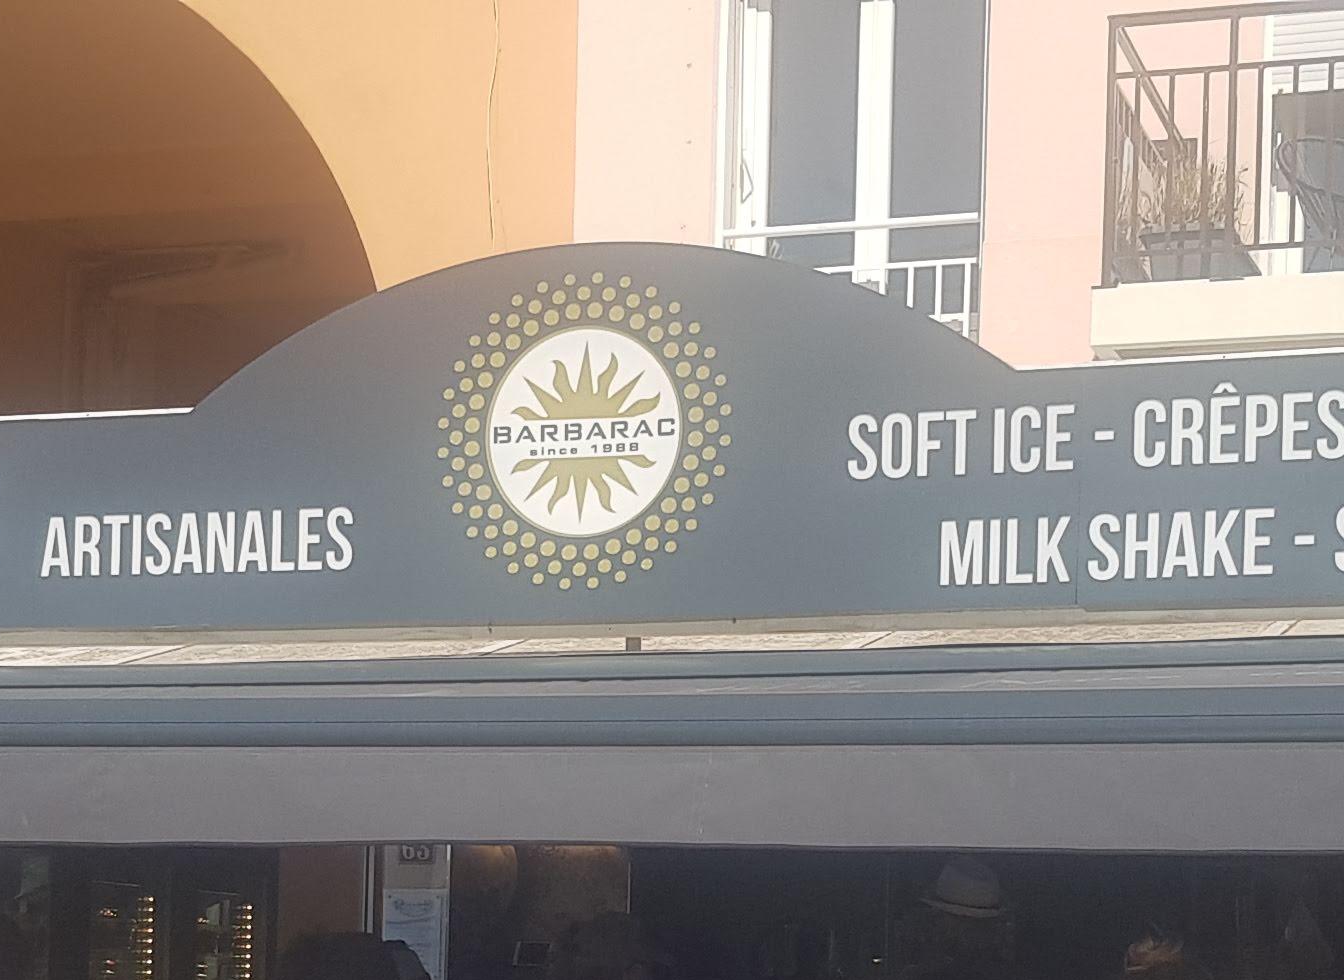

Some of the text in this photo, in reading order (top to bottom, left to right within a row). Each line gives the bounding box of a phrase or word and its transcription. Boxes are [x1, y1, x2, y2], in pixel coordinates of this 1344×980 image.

[493, 417, 676, 445] BARBARAC
[528, 441, 640, 457] since 1988
[847, 409, 977, 480] SOFT
[993, 404, 1075, 474] ICE
[40, 506, 354, 577] ARTISANALES
[939, 516, 1071, 586] MILK
[1087, 508, 1276, 581] SHAKE
